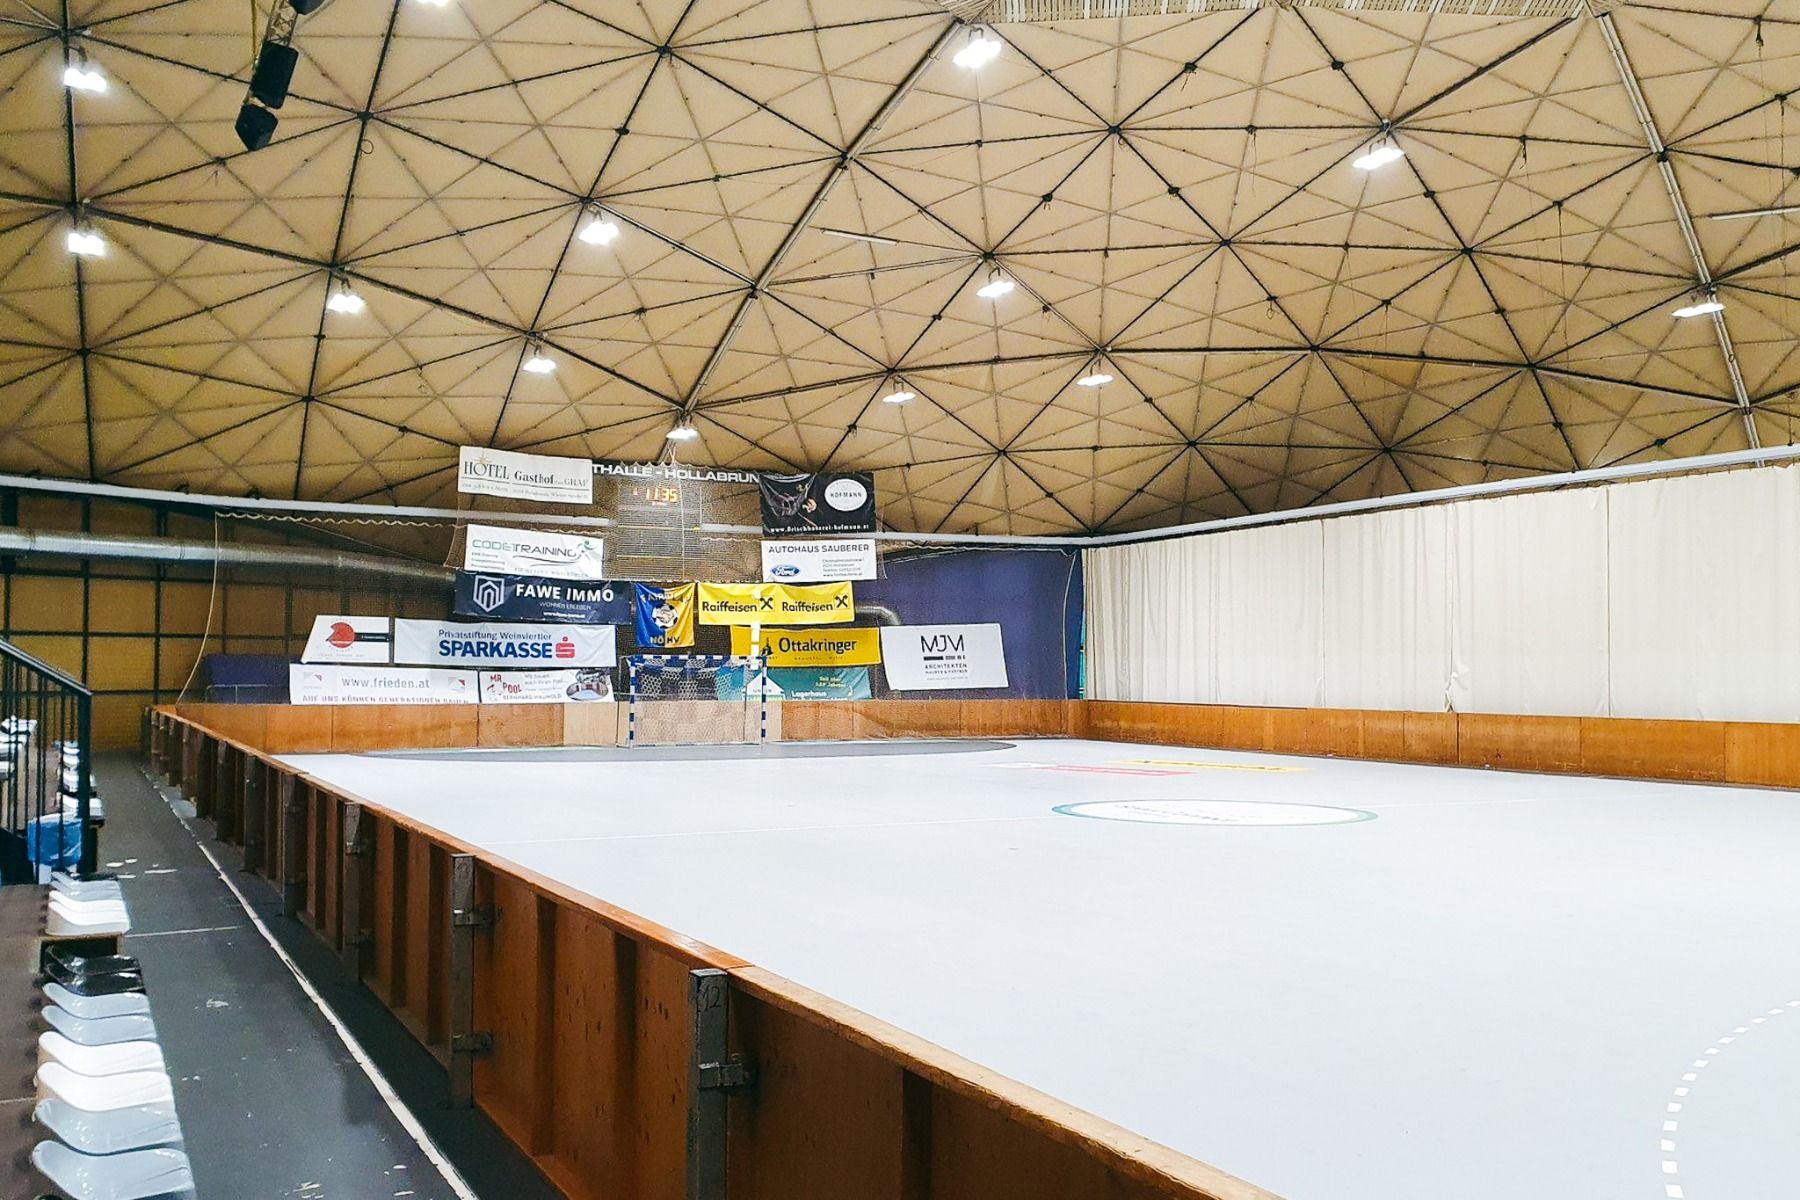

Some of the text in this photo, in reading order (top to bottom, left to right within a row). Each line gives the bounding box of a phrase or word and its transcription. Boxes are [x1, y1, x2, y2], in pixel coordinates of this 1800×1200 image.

[464, 461, 510, 480] HOTEL
[514, 470, 555, 484] Gasthof
[830, 491, 862, 499] HOFMANN
[768, 543, 870, 554] AUTOHAUS SAUBERER
[516, 584, 614, 603] FAWE IMMO
[702, 601, 833, 612] Raiffeisen Raiffeisen
[439, 629, 552, 641] Privatstiftung Weinviertler
[778, 637, 857, 654] Ottakringer
[920, 633, 965, 653] MJM
[439, 640, 553, 659] SPARKASSE
[341, 677, 430, 689] www.frieden.at
[490, 674, 502, 683] MR
[502, 682, 522, 694] POOL
[791, 690, 827, 698] Lagerhaus
[342, 694, 376, 703] KÖNNEN
[378, 696, 441, 704] GENERATIONEN
